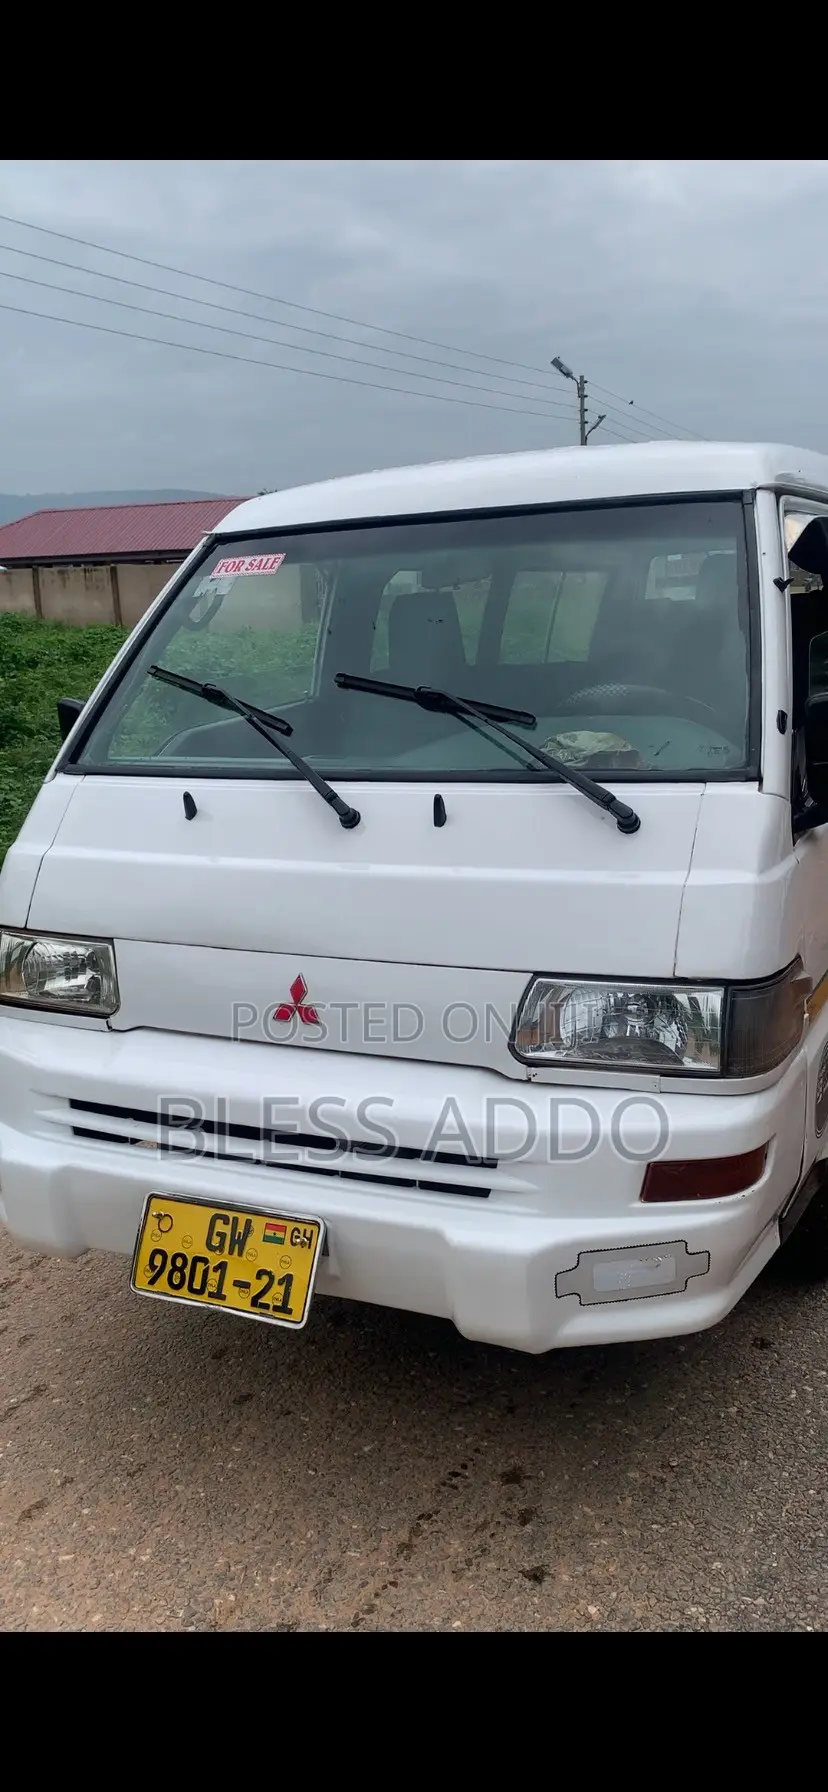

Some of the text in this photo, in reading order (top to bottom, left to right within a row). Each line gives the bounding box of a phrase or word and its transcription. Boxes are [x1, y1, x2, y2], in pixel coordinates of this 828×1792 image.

[218, 557, 280, 573] FOR SALE
[206, 1213, 252, 1257] GW
[147, 1247, 294, 1315] 9801-21
